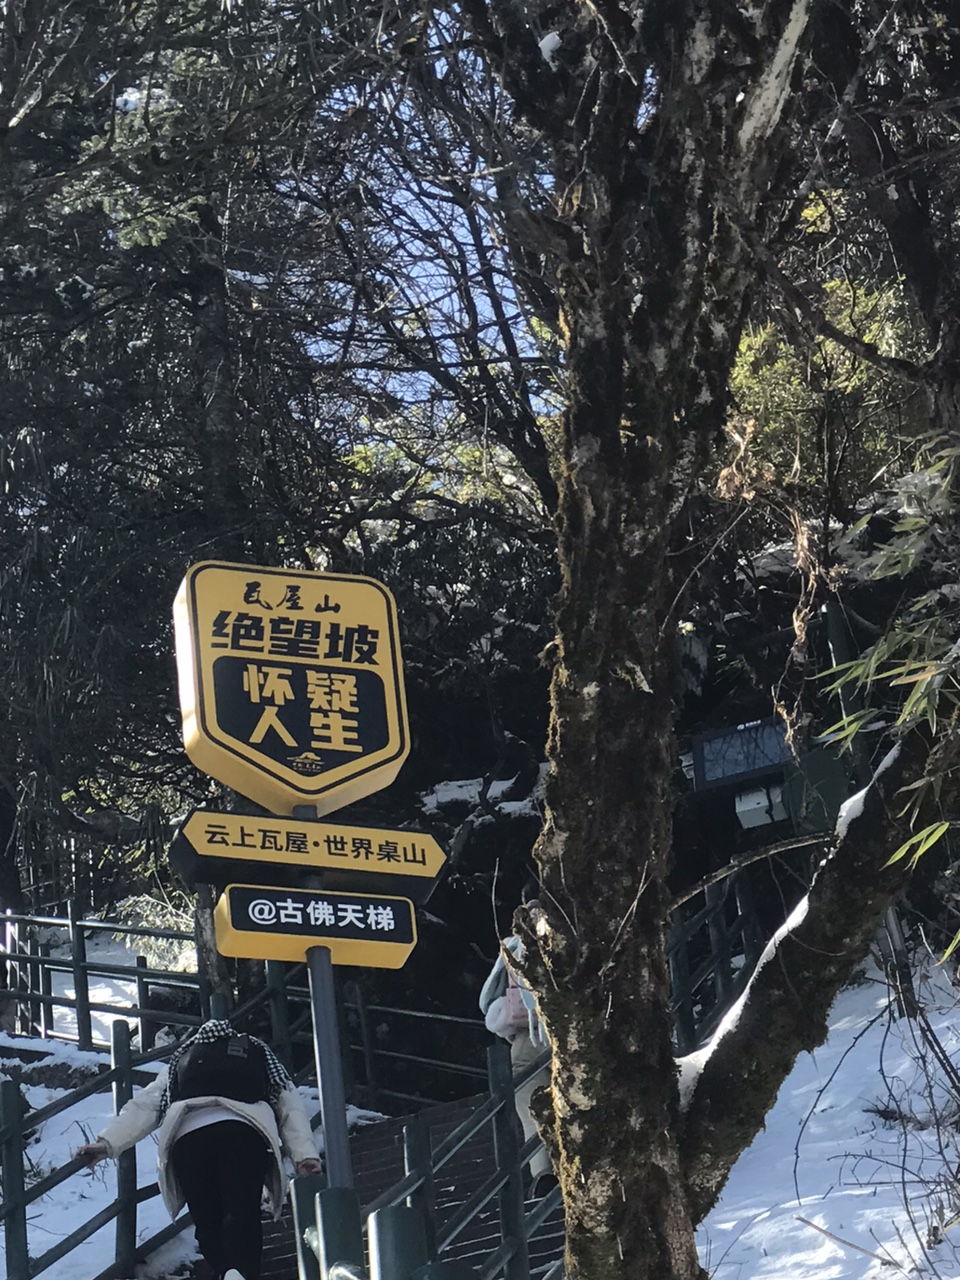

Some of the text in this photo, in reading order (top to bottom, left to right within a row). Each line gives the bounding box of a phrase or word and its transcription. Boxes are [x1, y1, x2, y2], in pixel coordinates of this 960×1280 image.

[211, 610, 380, 666] 绝望坡
[243, 664, 360, 713] 怀疑
[249, 705, 363, 753] 人生
[248, 898, 395, 932] @古佛天梯
